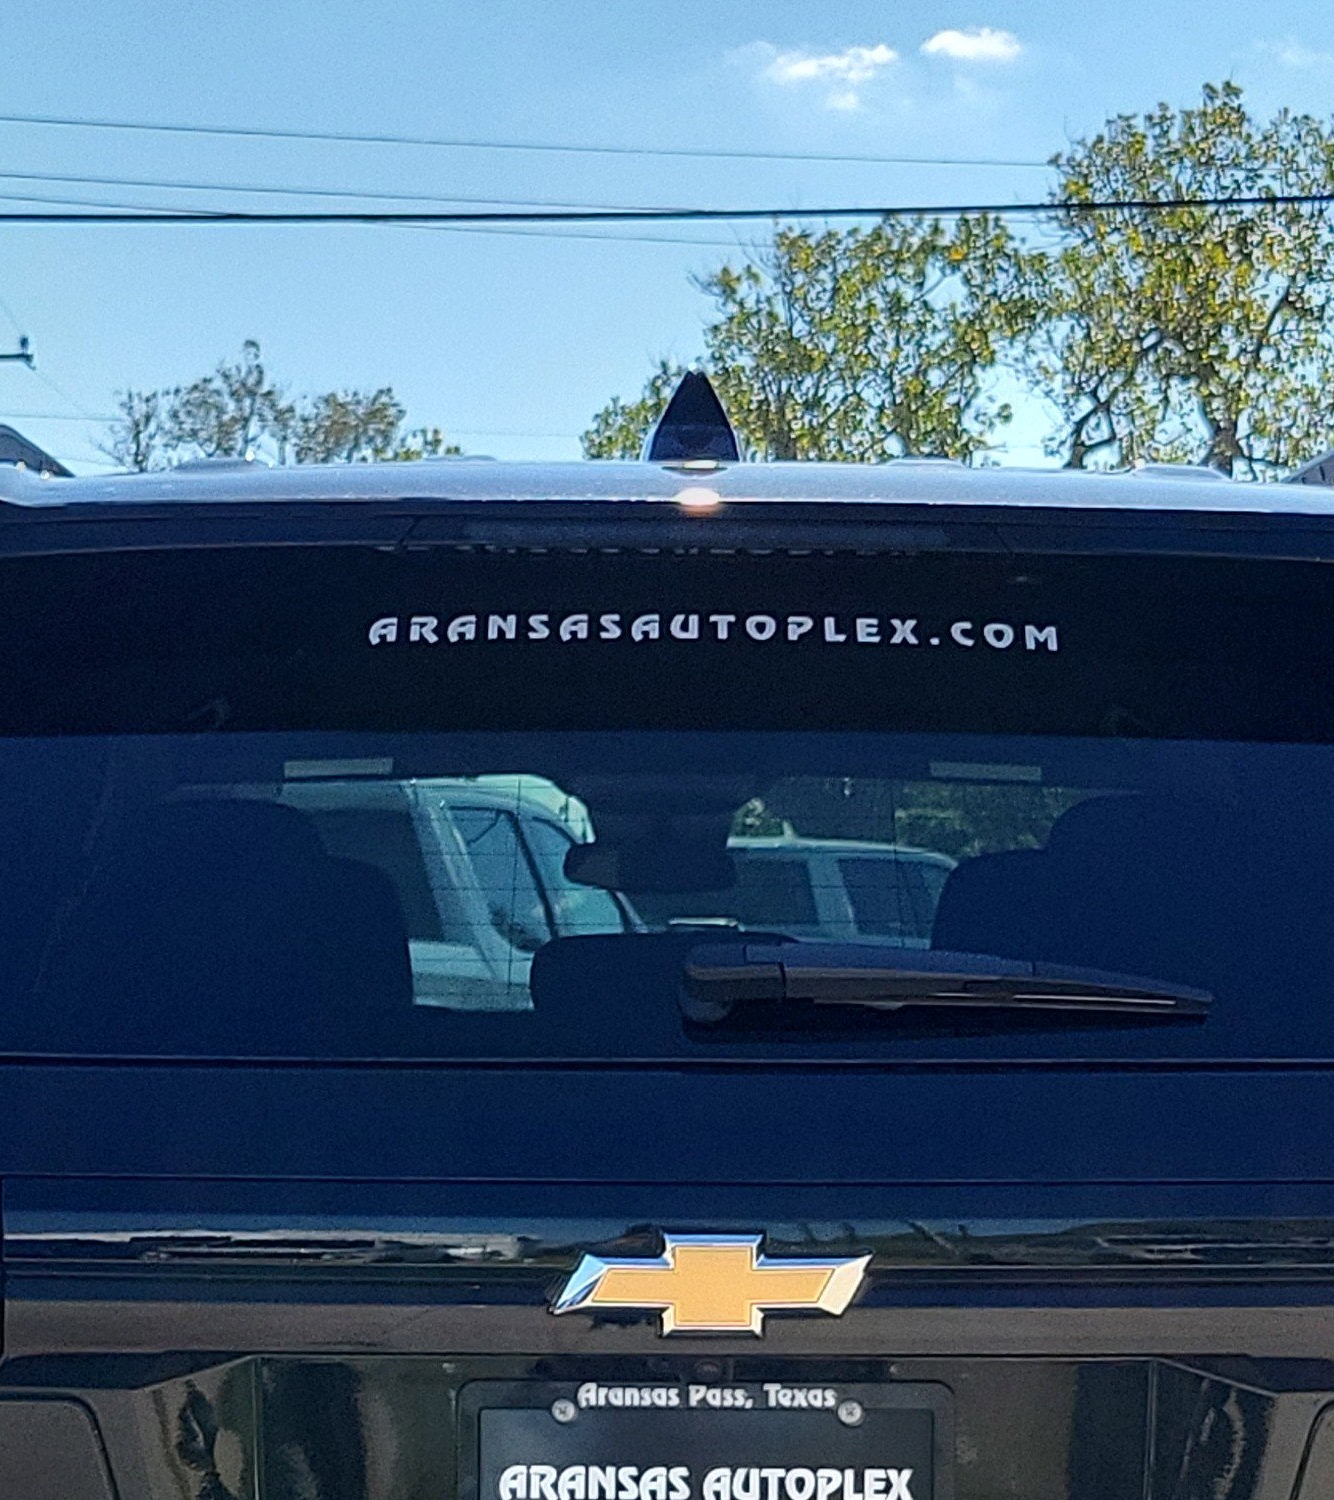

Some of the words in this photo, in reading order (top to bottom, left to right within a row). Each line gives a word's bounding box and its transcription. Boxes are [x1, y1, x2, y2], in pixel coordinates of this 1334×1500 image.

[368, 612, 1058, 652] ARANSASAUTOPLEX.COM
[576, 1381, 681, 1409] Aransas
[687, 1383, 754, 1410] Pass,
[762, 1382, 838, 1409] Texas
